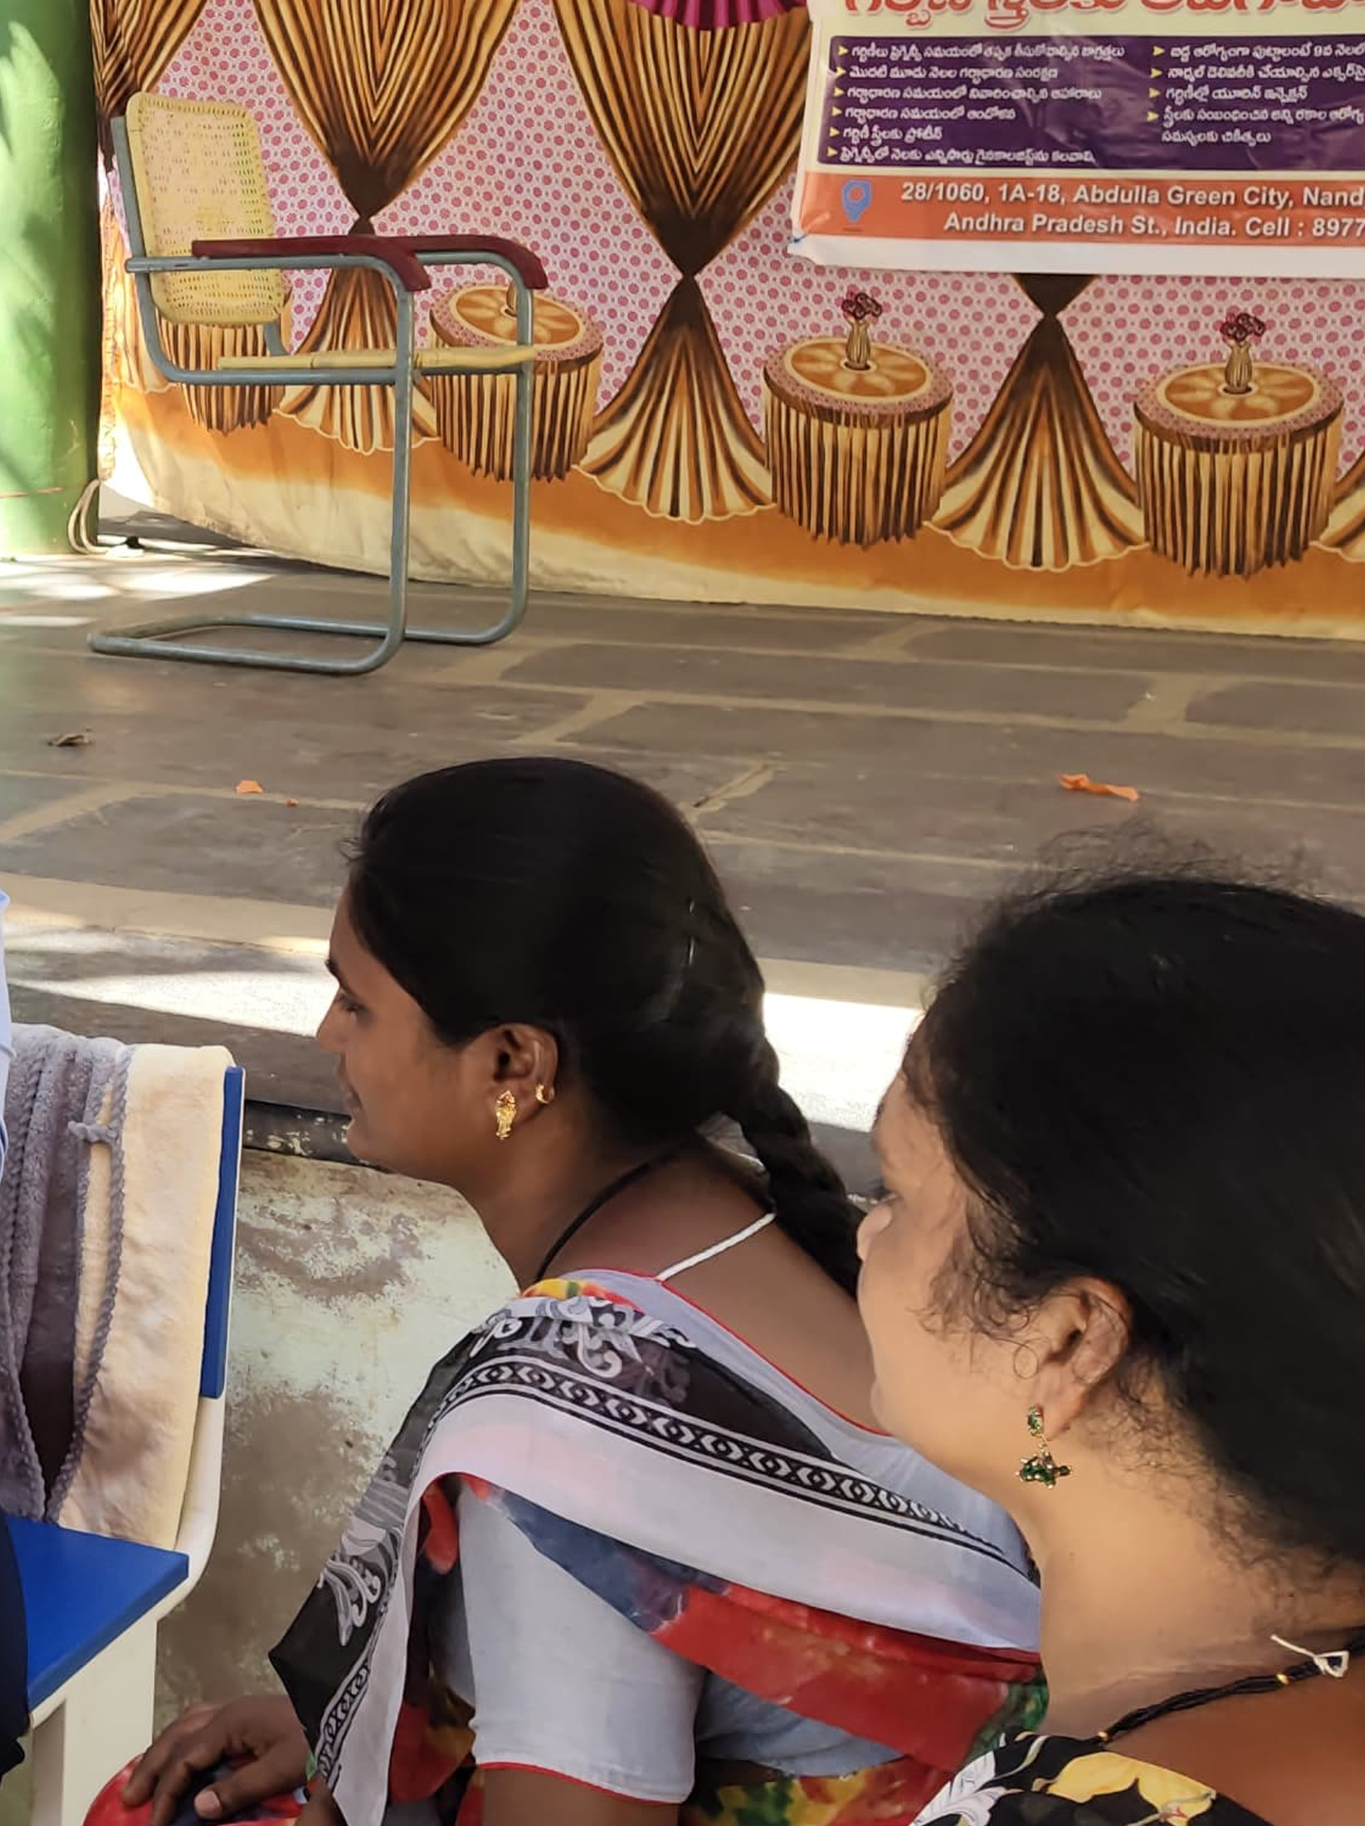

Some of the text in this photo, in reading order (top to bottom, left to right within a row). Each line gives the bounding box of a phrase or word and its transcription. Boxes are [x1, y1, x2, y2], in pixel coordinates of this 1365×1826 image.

[901, 181, 989, 204] 28/1060,
[998, 184, 1066, 206] 1A-18,
[1073, 184, 1160, 204] Abdulla
[1167, 185, 1236, 206] Green
[1243, 186, 1294, 209] City,
[943, 212, 1025, 232] Andhra
[1031, 214, 1124, 234] Pradesh
[1130, 215, 1168, 236] St.,
[1174, 216, 1237, 236] India.
[1245, 217, 1290, 237] Cell
[1312, 217, 1365, 238] 8977
